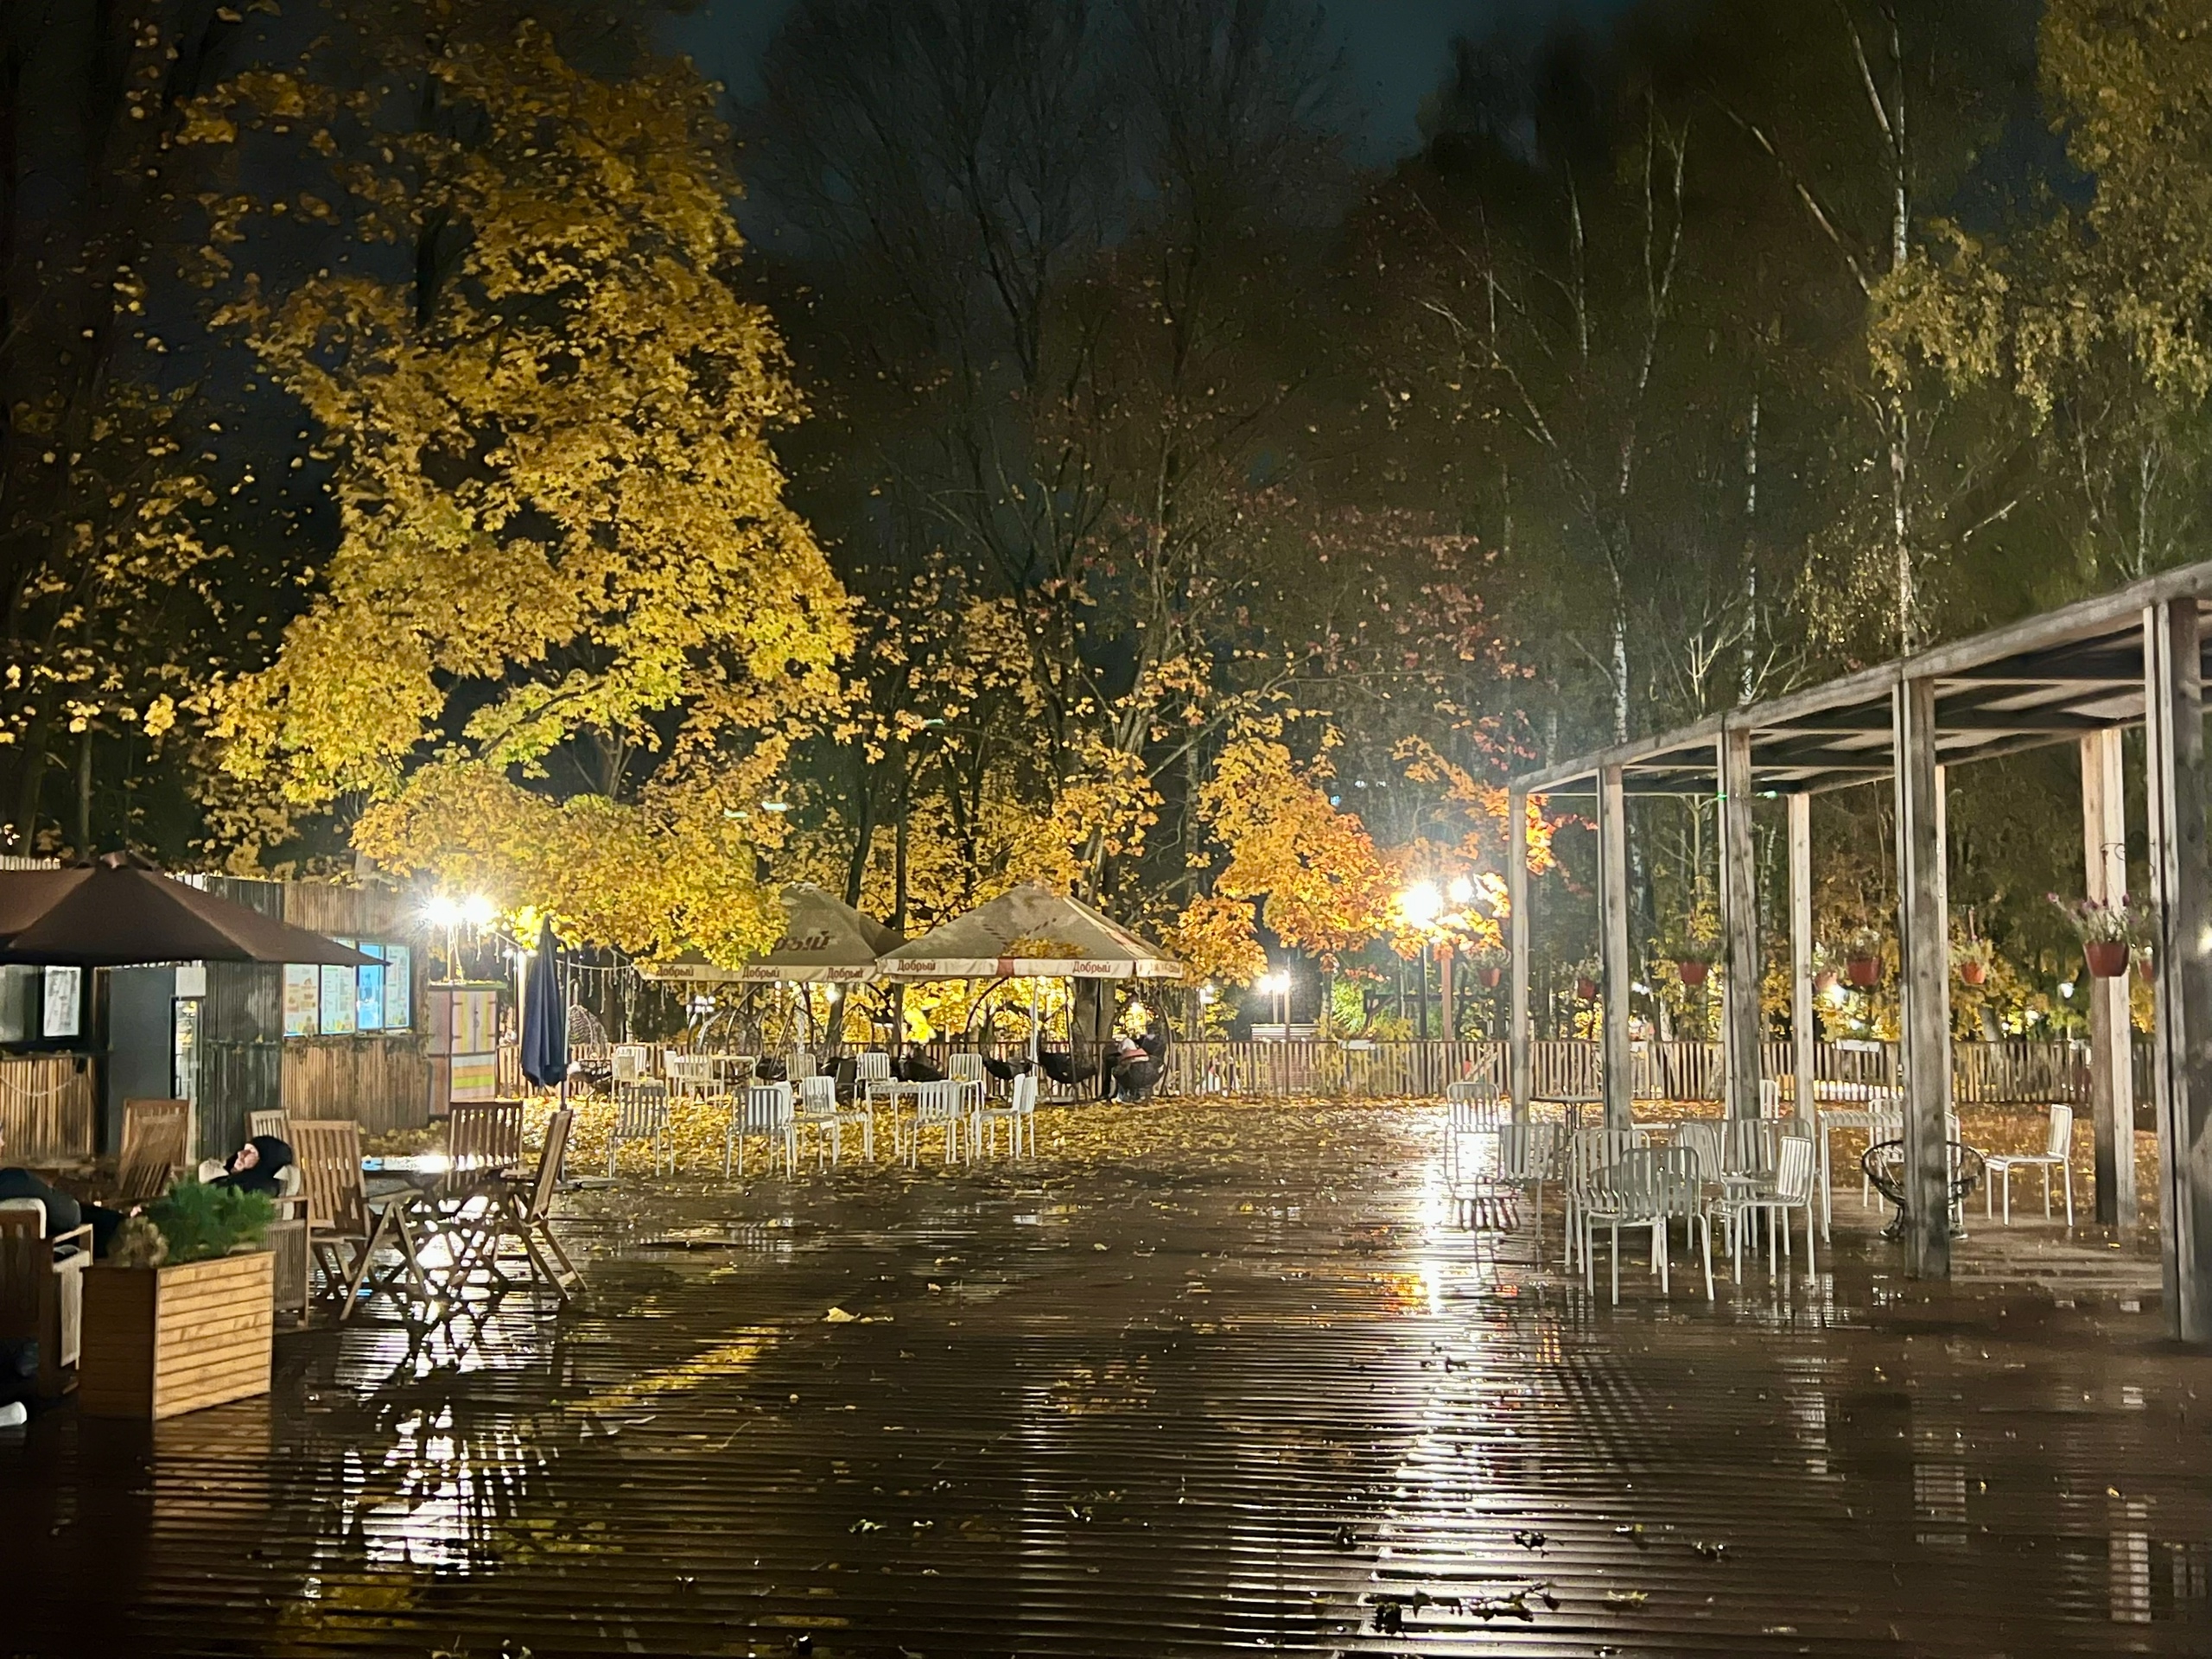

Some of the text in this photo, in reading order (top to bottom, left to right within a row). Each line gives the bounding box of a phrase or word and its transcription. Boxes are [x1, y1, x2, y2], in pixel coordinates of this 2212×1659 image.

[898, 959, 936, 972] Добрый
[1072, 961, 1111, 974] Добрый
[742, 966, 780, 979] Добрый
[827, 967, 864, 980] Добрый
